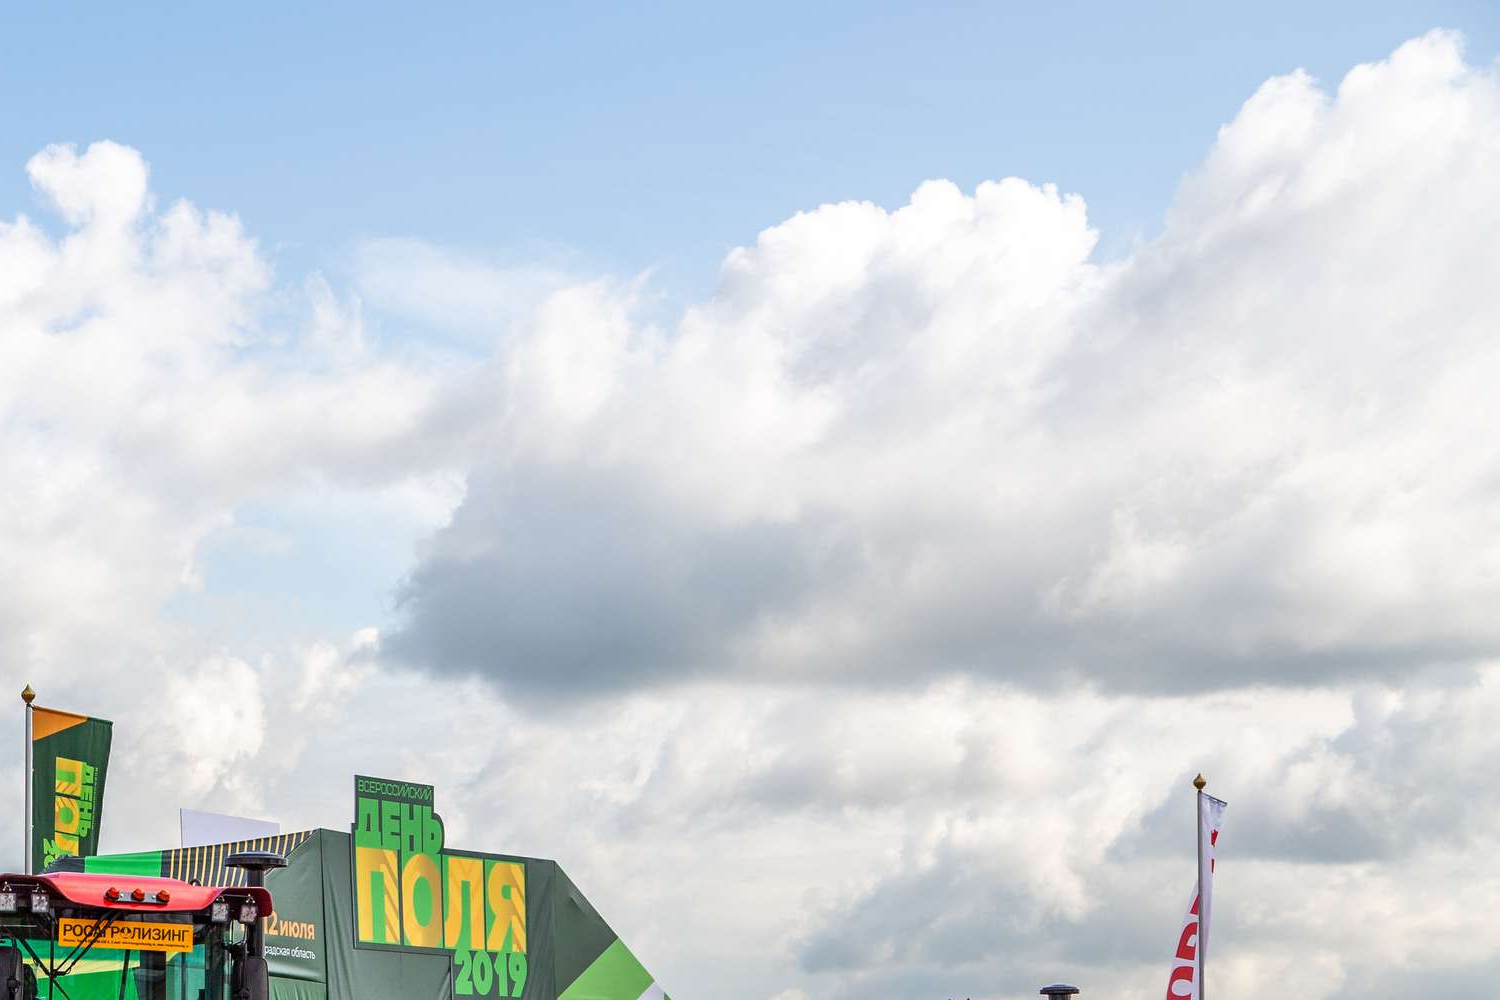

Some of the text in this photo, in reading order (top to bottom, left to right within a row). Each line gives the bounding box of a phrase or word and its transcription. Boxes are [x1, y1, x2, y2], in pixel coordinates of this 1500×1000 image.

[78, 761, 95, 837] ДЕНЬ
[358, 779, 433, 800] ВСЕРОССИЙСКИЙ
[356, 797, 443, 853] ДЕНЬ
[356, 846, 527, 955] ПОЛЯ
[280, 920, 315, 940] июля
[291, 947, 316, 960] область
[454, 951, 528, 998] 2019
